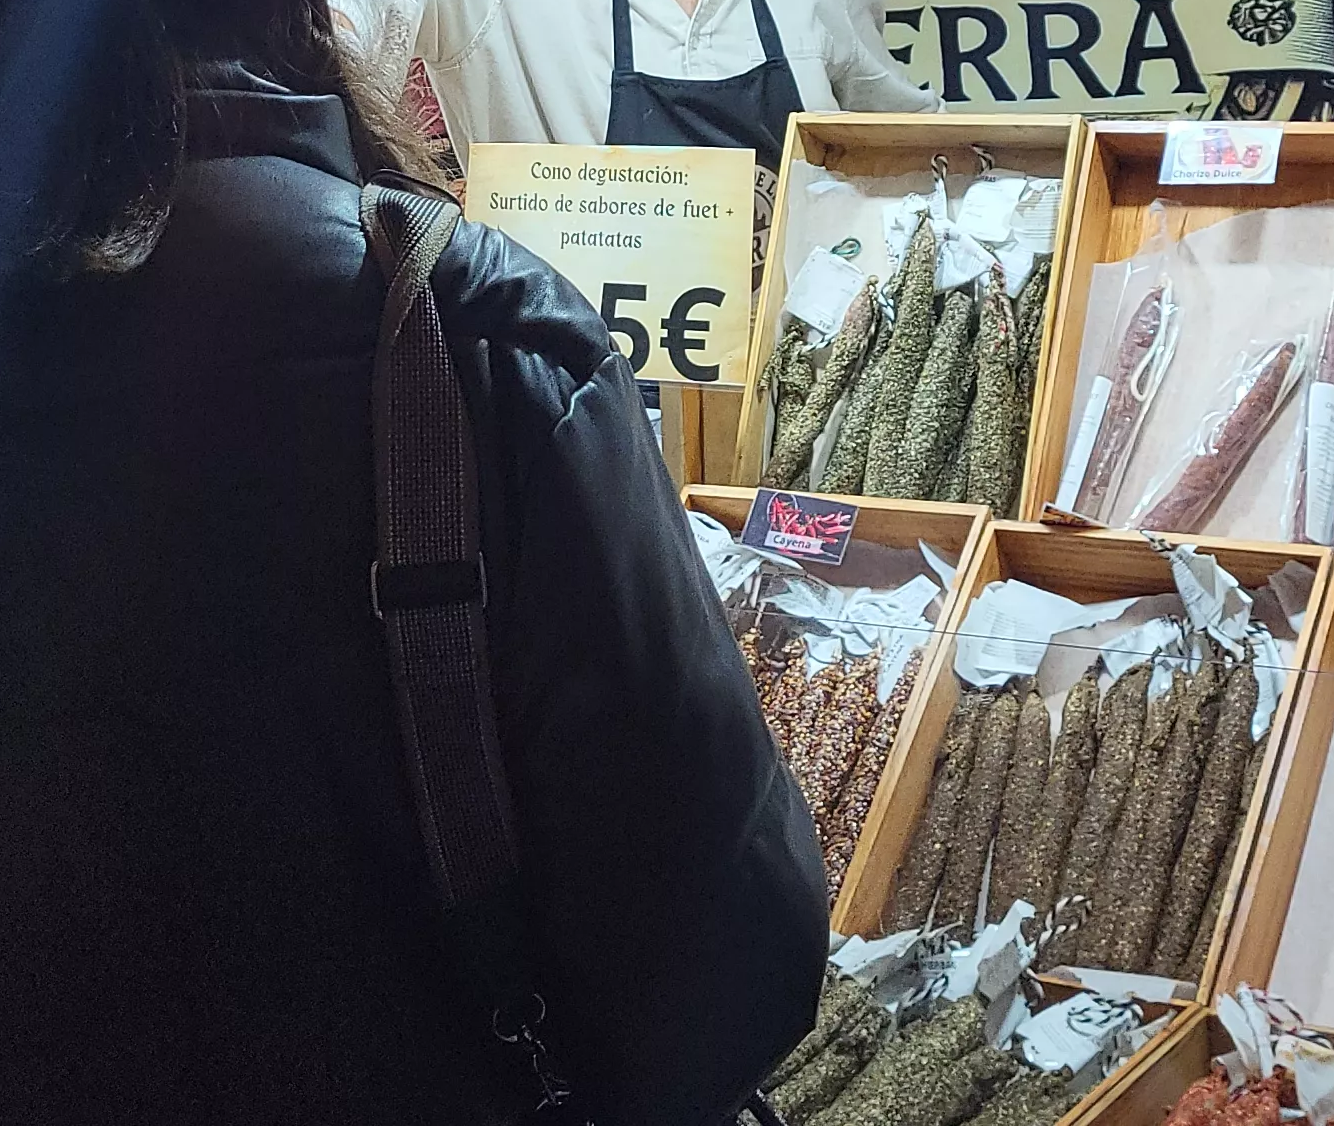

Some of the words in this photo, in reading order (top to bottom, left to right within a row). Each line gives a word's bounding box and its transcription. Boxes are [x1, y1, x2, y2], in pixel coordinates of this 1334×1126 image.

[530, 161, 572, 181] Cono
[578, 163, 689, 186] degustación:
[1173, 169, 1210, 178] Chorizo
[1213, 169, 1242, 178] Dulce
[489, 192, 548, 212] Surtido
[554, 194, 573, 213] de
[579, 196, 647, 216] sabores
[653, 199, 675, 217] de
[682, 199, 719, 220] fuet
[560, 229, 643, 249] patatatas
[600, 282, 726, 382] 5€
[773, 534, 812, 549] Cayena
